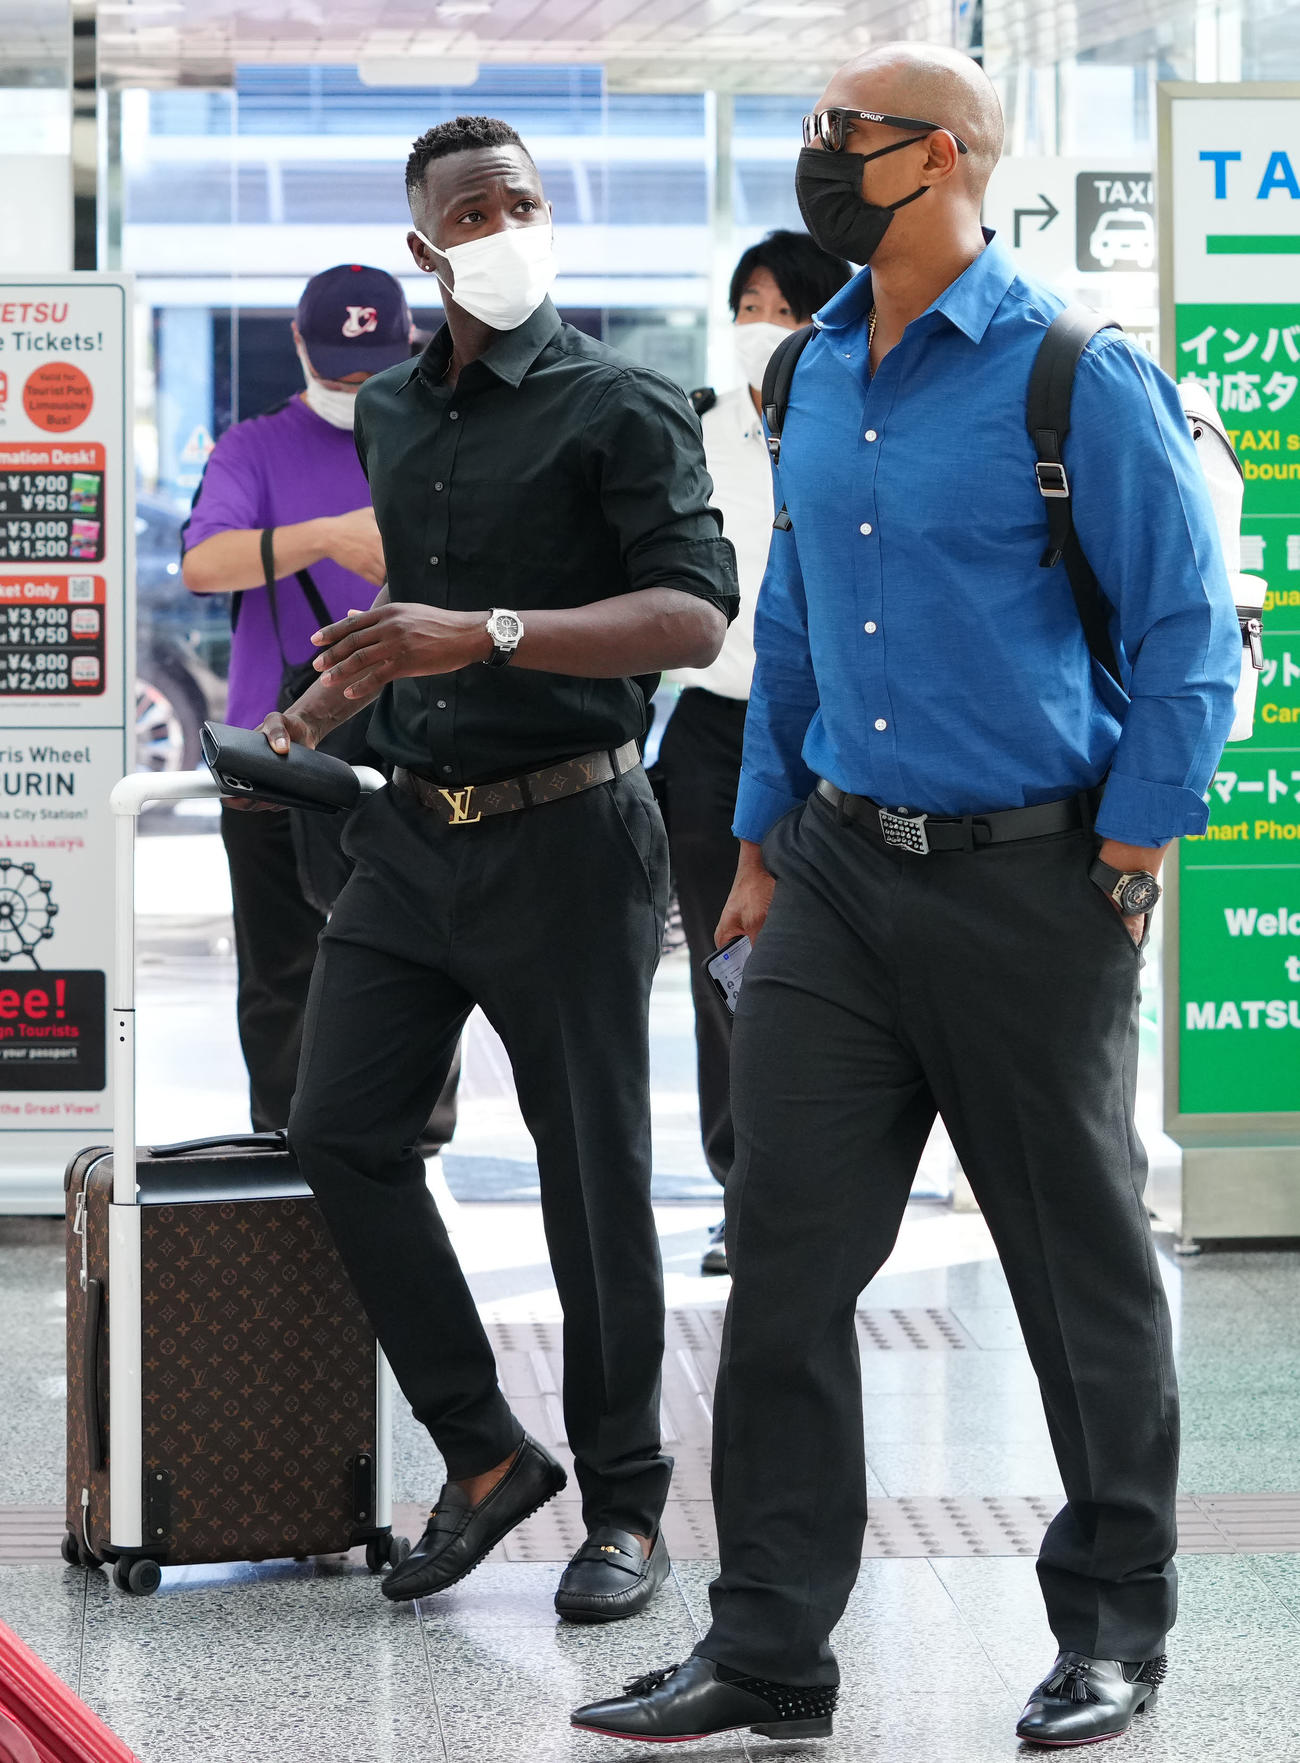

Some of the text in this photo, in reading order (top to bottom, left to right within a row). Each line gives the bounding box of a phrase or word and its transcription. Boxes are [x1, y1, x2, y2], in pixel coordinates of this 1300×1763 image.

[860, 112, 884, 122] OAKLEY
[1093, 180, 1155, 204] TAXI
[0, 302, 69, 323] ETSU
[12, 331, 103, 351] Tickets!
[1180, 324, 1300, 365] インバ
[51, 448, 96, 465] Desk!
[1241, 459, 1300, 480] boun
[21, 494, 68, 511] ¥950
[23, 582, 59, 601] Only
[29, 746, 91, 763] Wheel
[1202, 769, 1300, 804] マート
[14, 809, 36, 822] City
[40, 808, 88, 820] Station!
[1185, 821, 1249, 842] mart
[0, 979, 66, 1019] ee!
[19, 1023, 80, 1038] Tourists
[25, 1103, 60, 1116] Great
